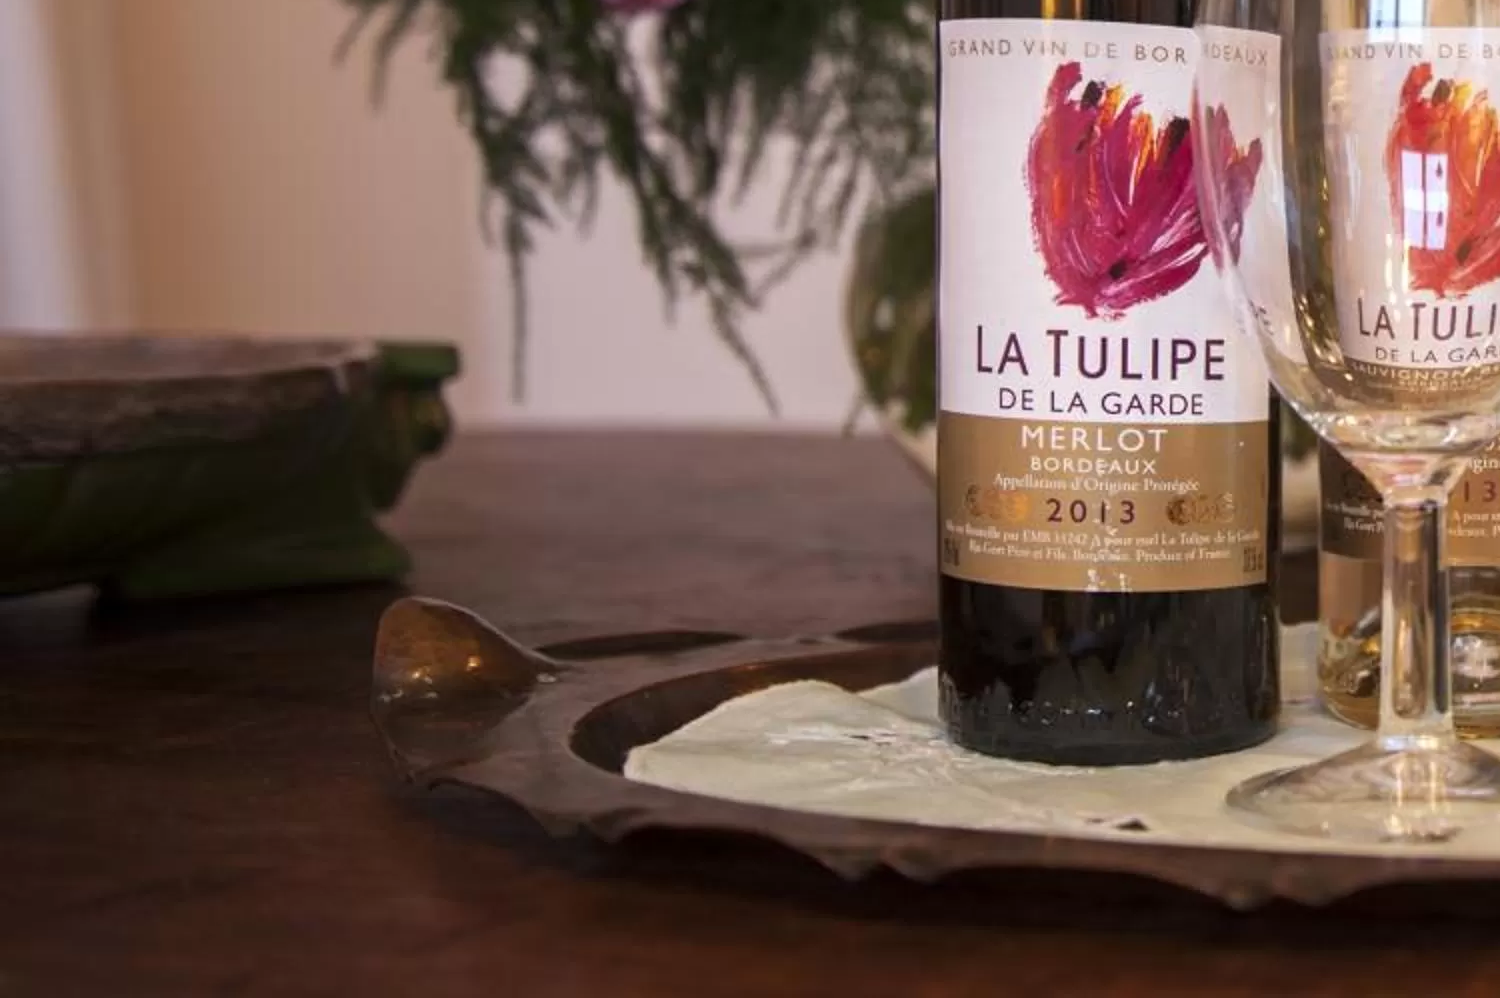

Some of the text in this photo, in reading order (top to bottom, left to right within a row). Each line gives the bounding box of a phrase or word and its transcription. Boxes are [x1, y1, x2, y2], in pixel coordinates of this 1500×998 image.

[949, 39, 1012, 58] GRAND
[1022, 41, 1068, 59] VIN
[1084, 42, 1118, 59] DE
[1384, 43, 1423, 59] VIN
[1438, 43, 1471, 59] DE
[1357, 297, 1395, 338] LA
[977, 325, 1225, 381] LA TULIPE
[1375, 346, 1400, 362] DE
[1411, 350, 1439, 364] LA
[999, 387, 1204, 416] DE LA GARDE
[1021, 425, 1168, 452] MERLOT
[1031, 456, 1156, 476] BORDEAUX
[992, 473, 1066, 491] Appellation
[1046, 497, 1135, 525] 2013
